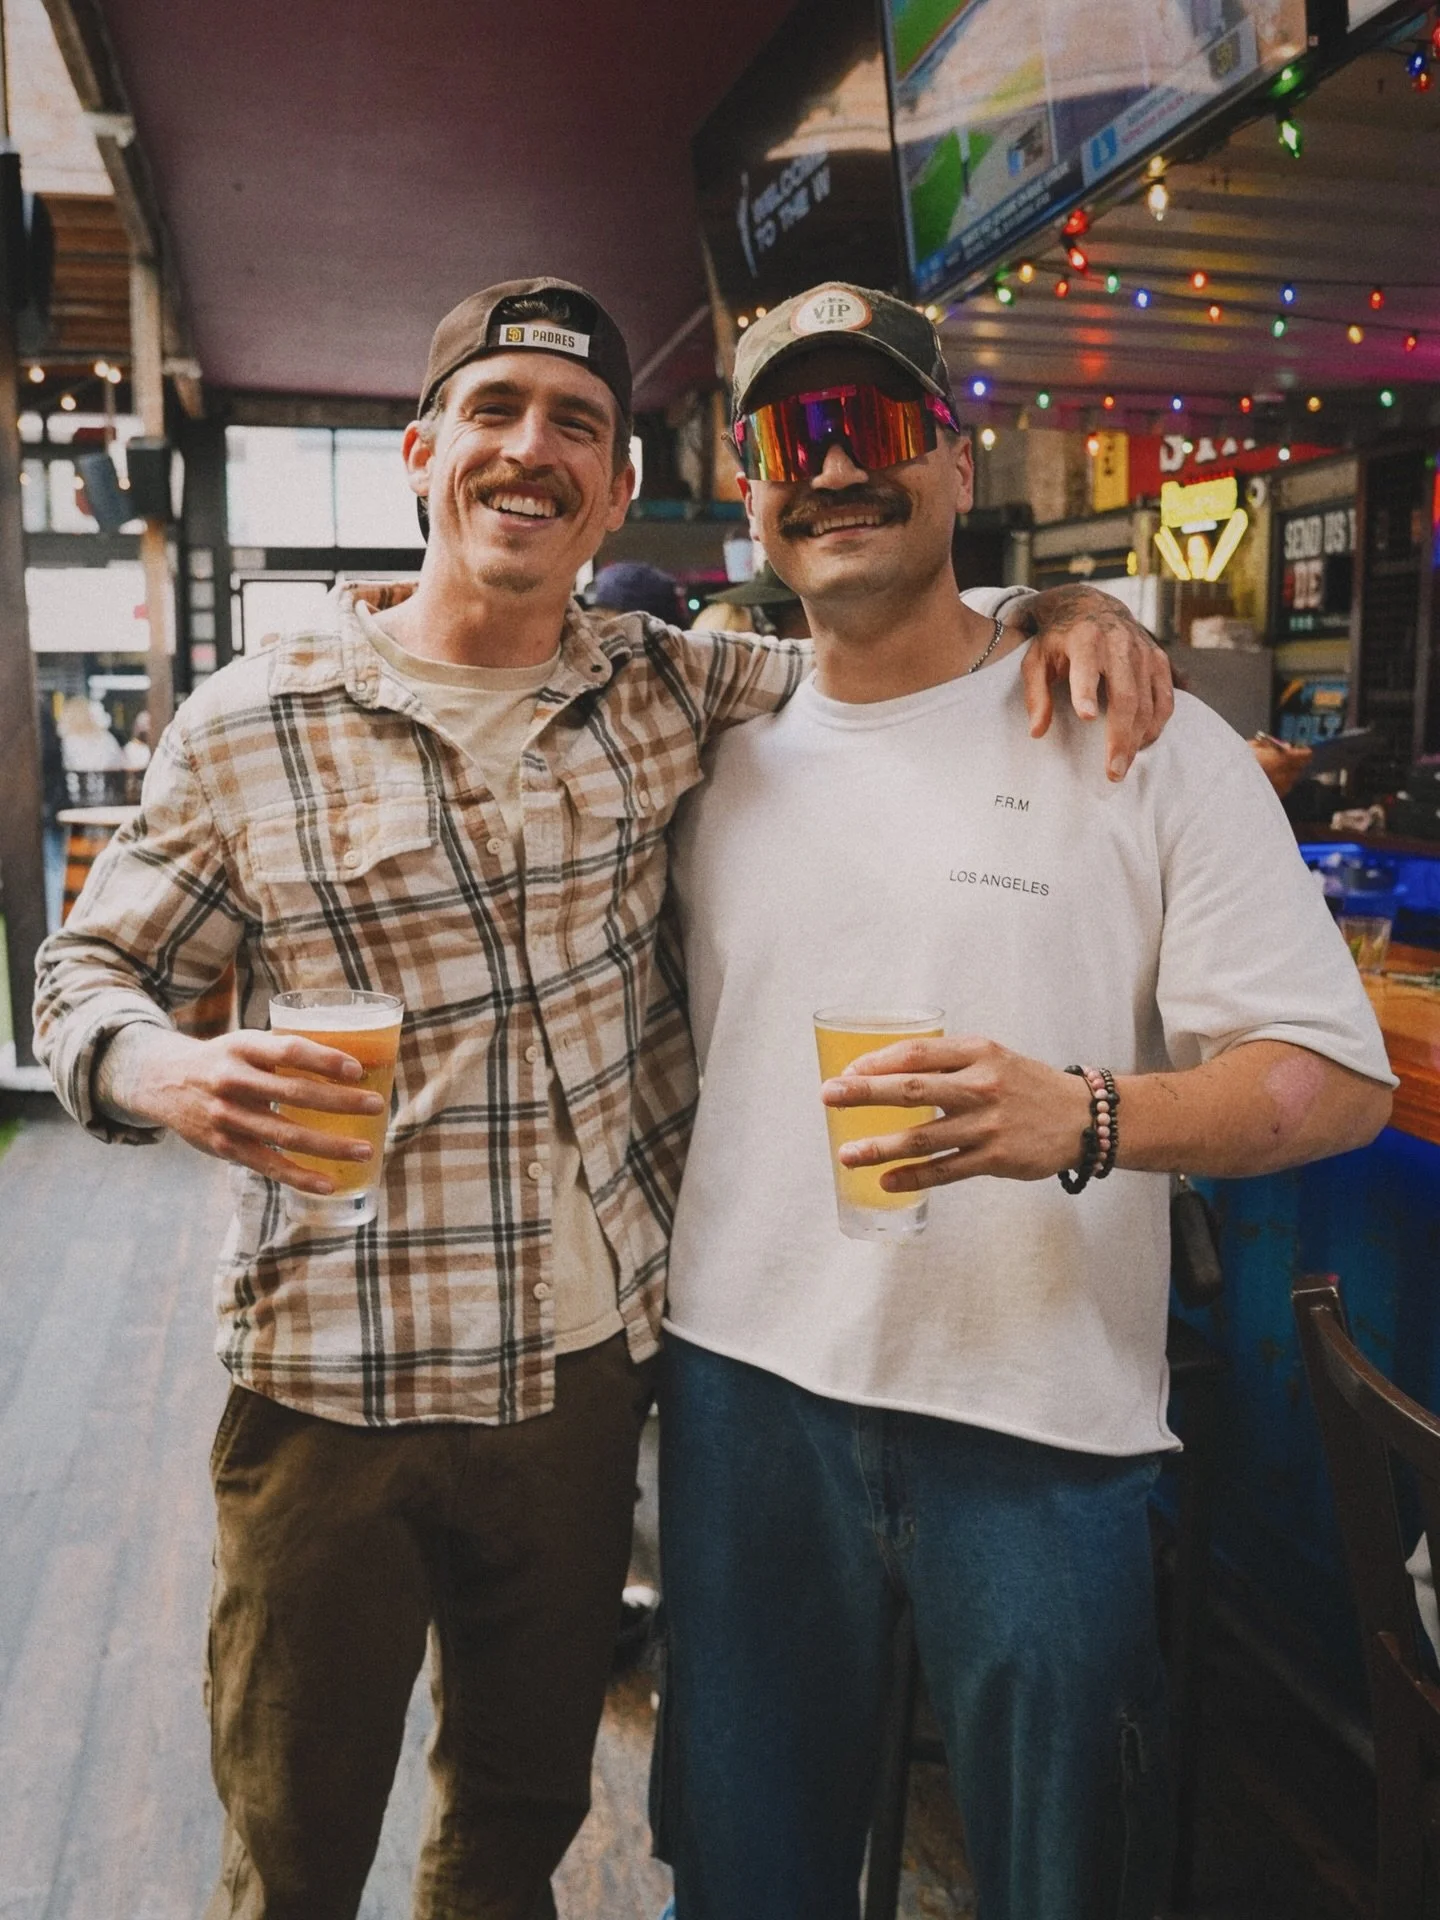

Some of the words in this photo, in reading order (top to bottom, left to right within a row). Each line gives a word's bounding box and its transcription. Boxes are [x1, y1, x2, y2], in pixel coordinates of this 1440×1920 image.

[813, 304, 851, 320] VIP
[532, 329, 575, 348] PADRES
[994, 795, 1029, 812] F.R.M
[949, 869, 977, 884] LOS
[980, 873, 1050, 896] ANGELES
